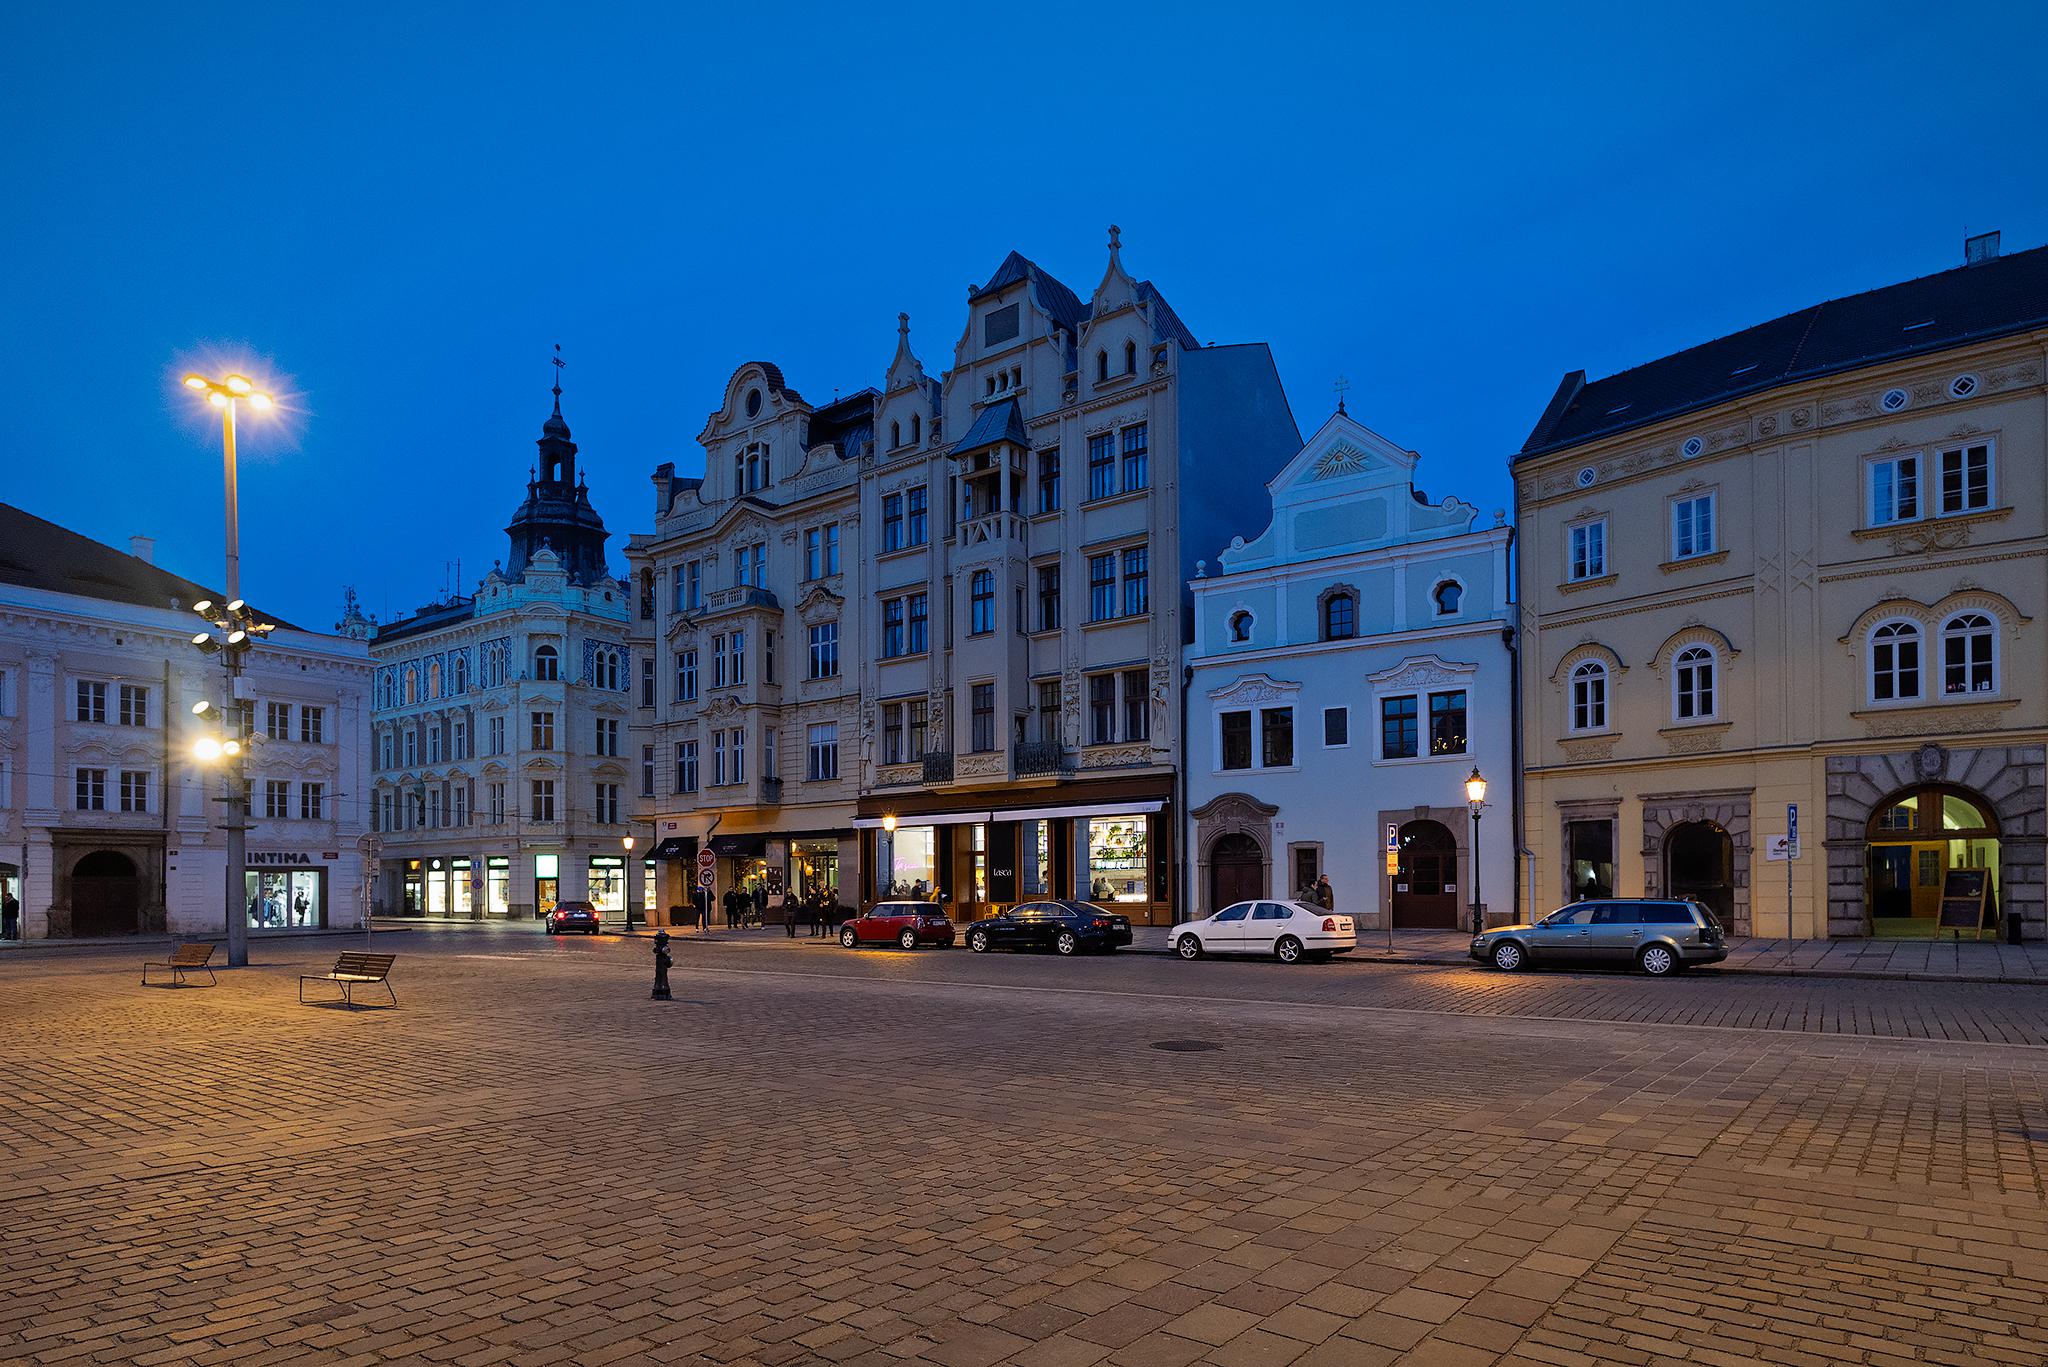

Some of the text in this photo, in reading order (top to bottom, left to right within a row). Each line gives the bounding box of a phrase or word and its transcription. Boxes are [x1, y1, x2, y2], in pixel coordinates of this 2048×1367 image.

[1389, 826, 1396, 844] P
[247, 852, 310, 864] INTIMA
[699, 854, 714, 862] STOP
